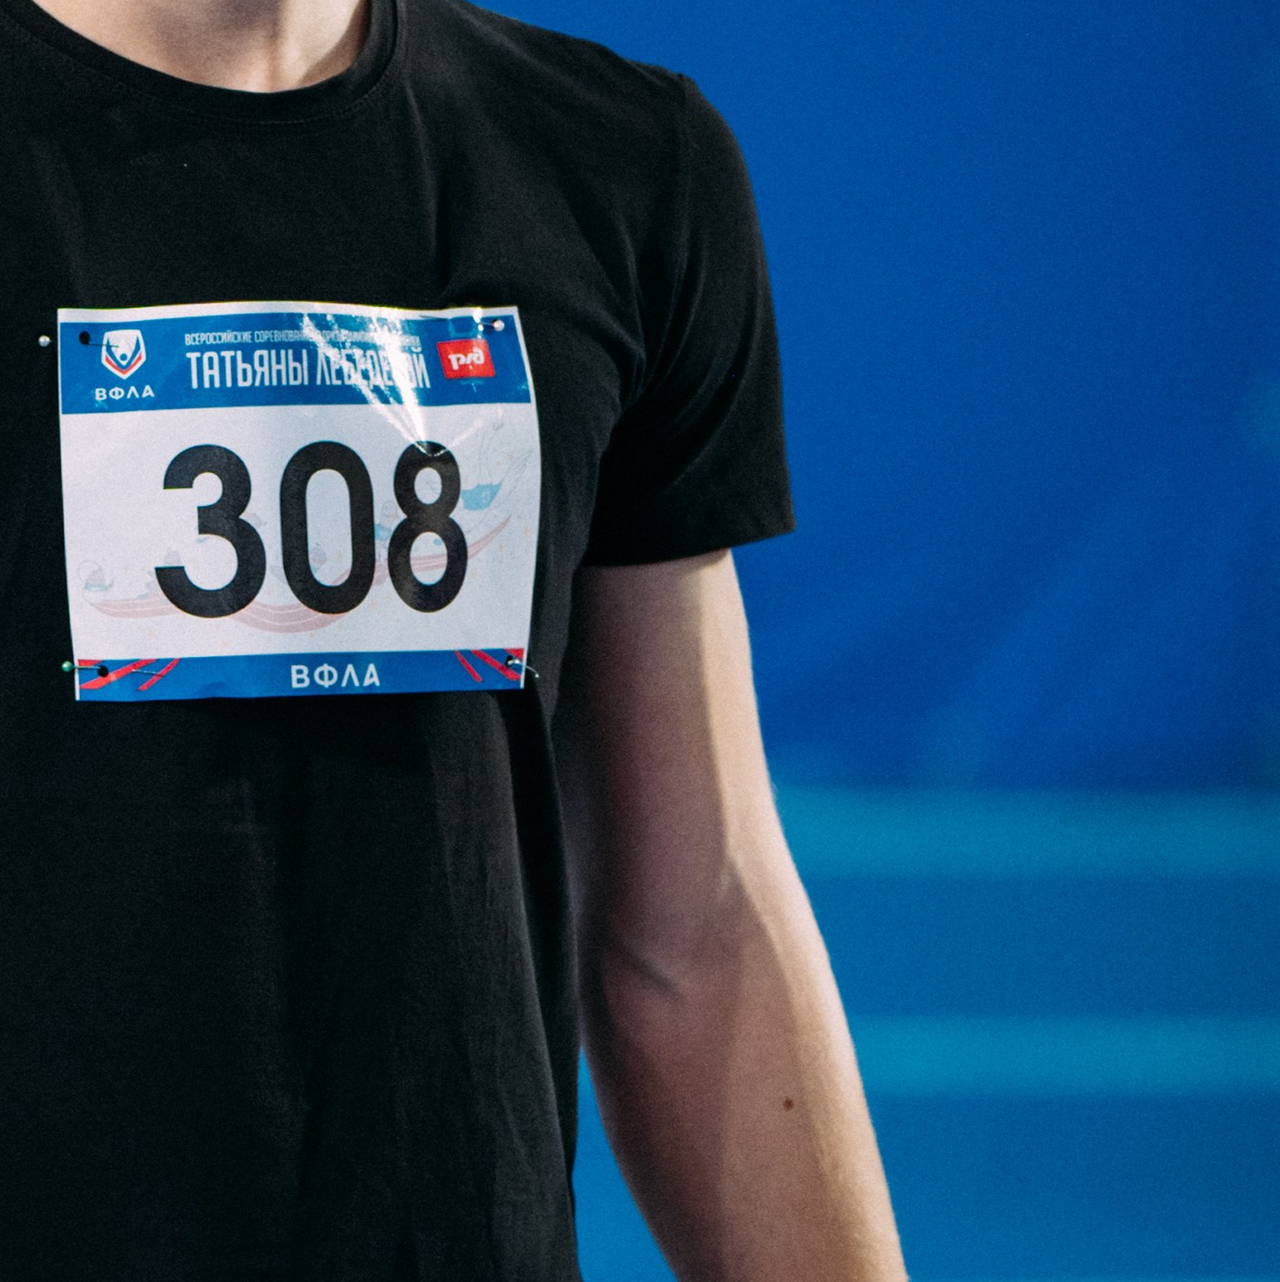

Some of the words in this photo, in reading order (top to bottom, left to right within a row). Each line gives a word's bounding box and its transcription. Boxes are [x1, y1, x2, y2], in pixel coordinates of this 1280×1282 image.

[185, 349, 309, 389] ТАТЬЯНЫ
[316, 345, 431, 389] ЛЕБЕДЕОЙ
[95, 384, 155, 401] ВФЛА
[154, 440, 468, 619] 308
[291, 663, 380, 689] ВФЛА
